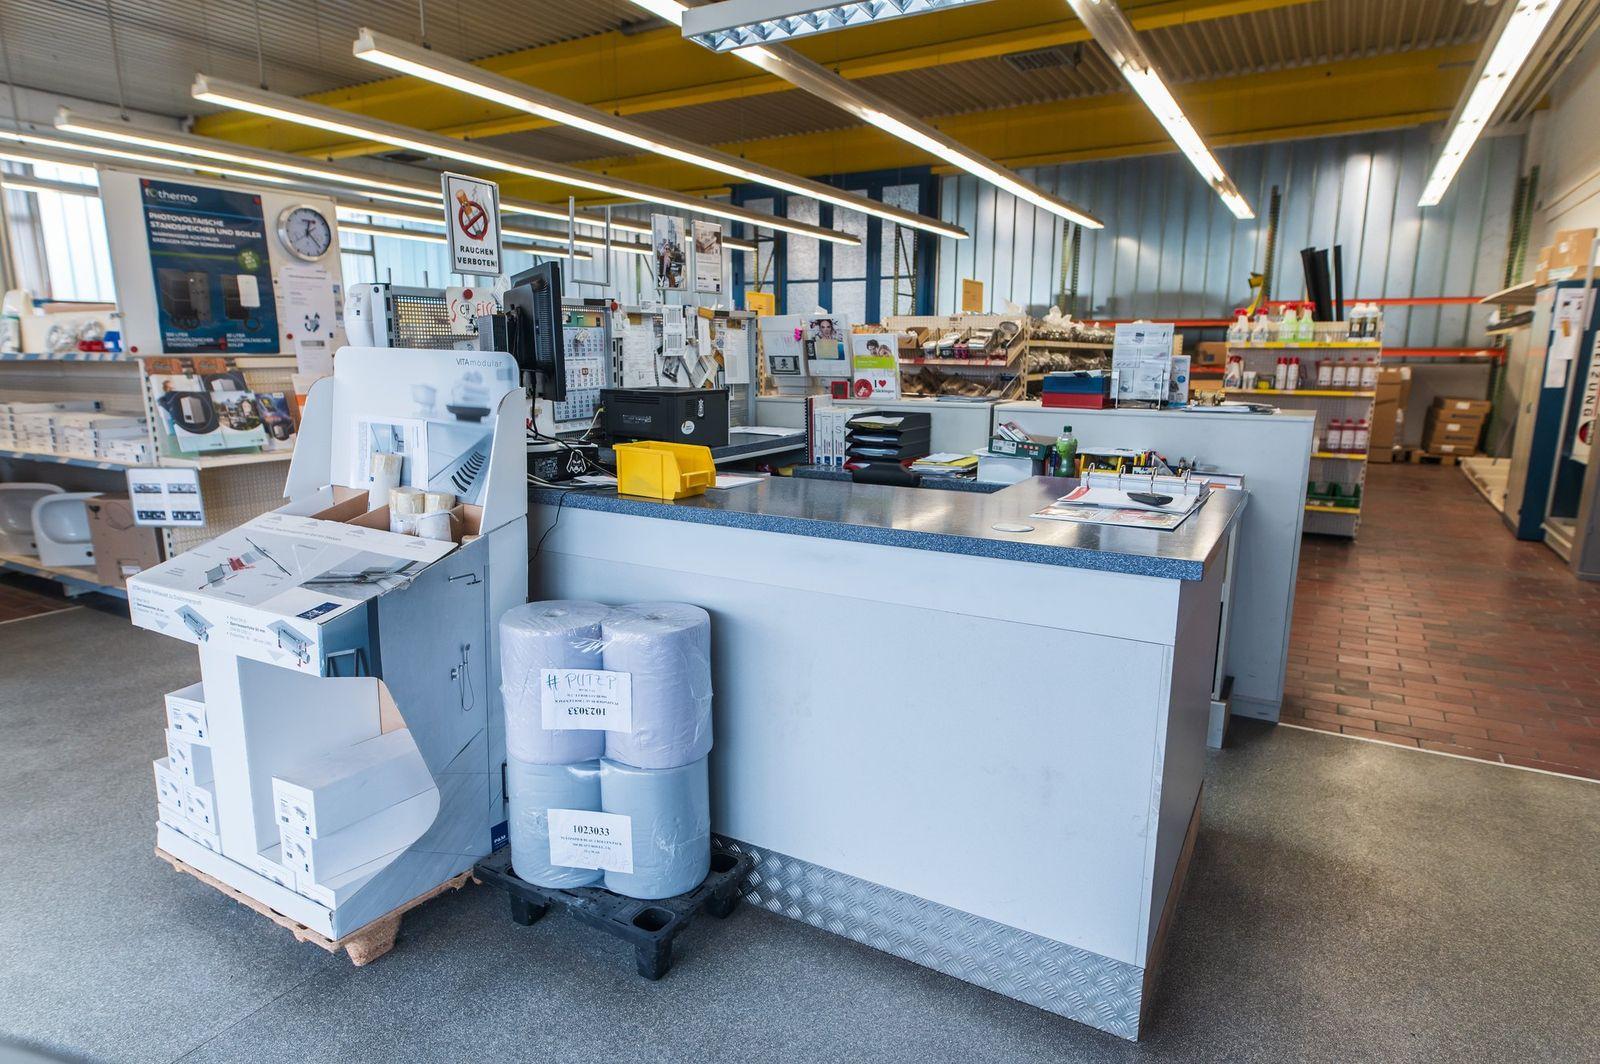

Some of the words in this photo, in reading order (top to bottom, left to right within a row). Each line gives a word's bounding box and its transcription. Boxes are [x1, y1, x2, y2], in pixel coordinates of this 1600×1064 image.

[216, 228, 233, 236] UND
[460, 245, 494, 256] RAUCHEN
[457, 256, 497, 267] VERBOTEN!
[567, 706, 606, 716] 1023033
[573, 825, 610, 836] 1023033
